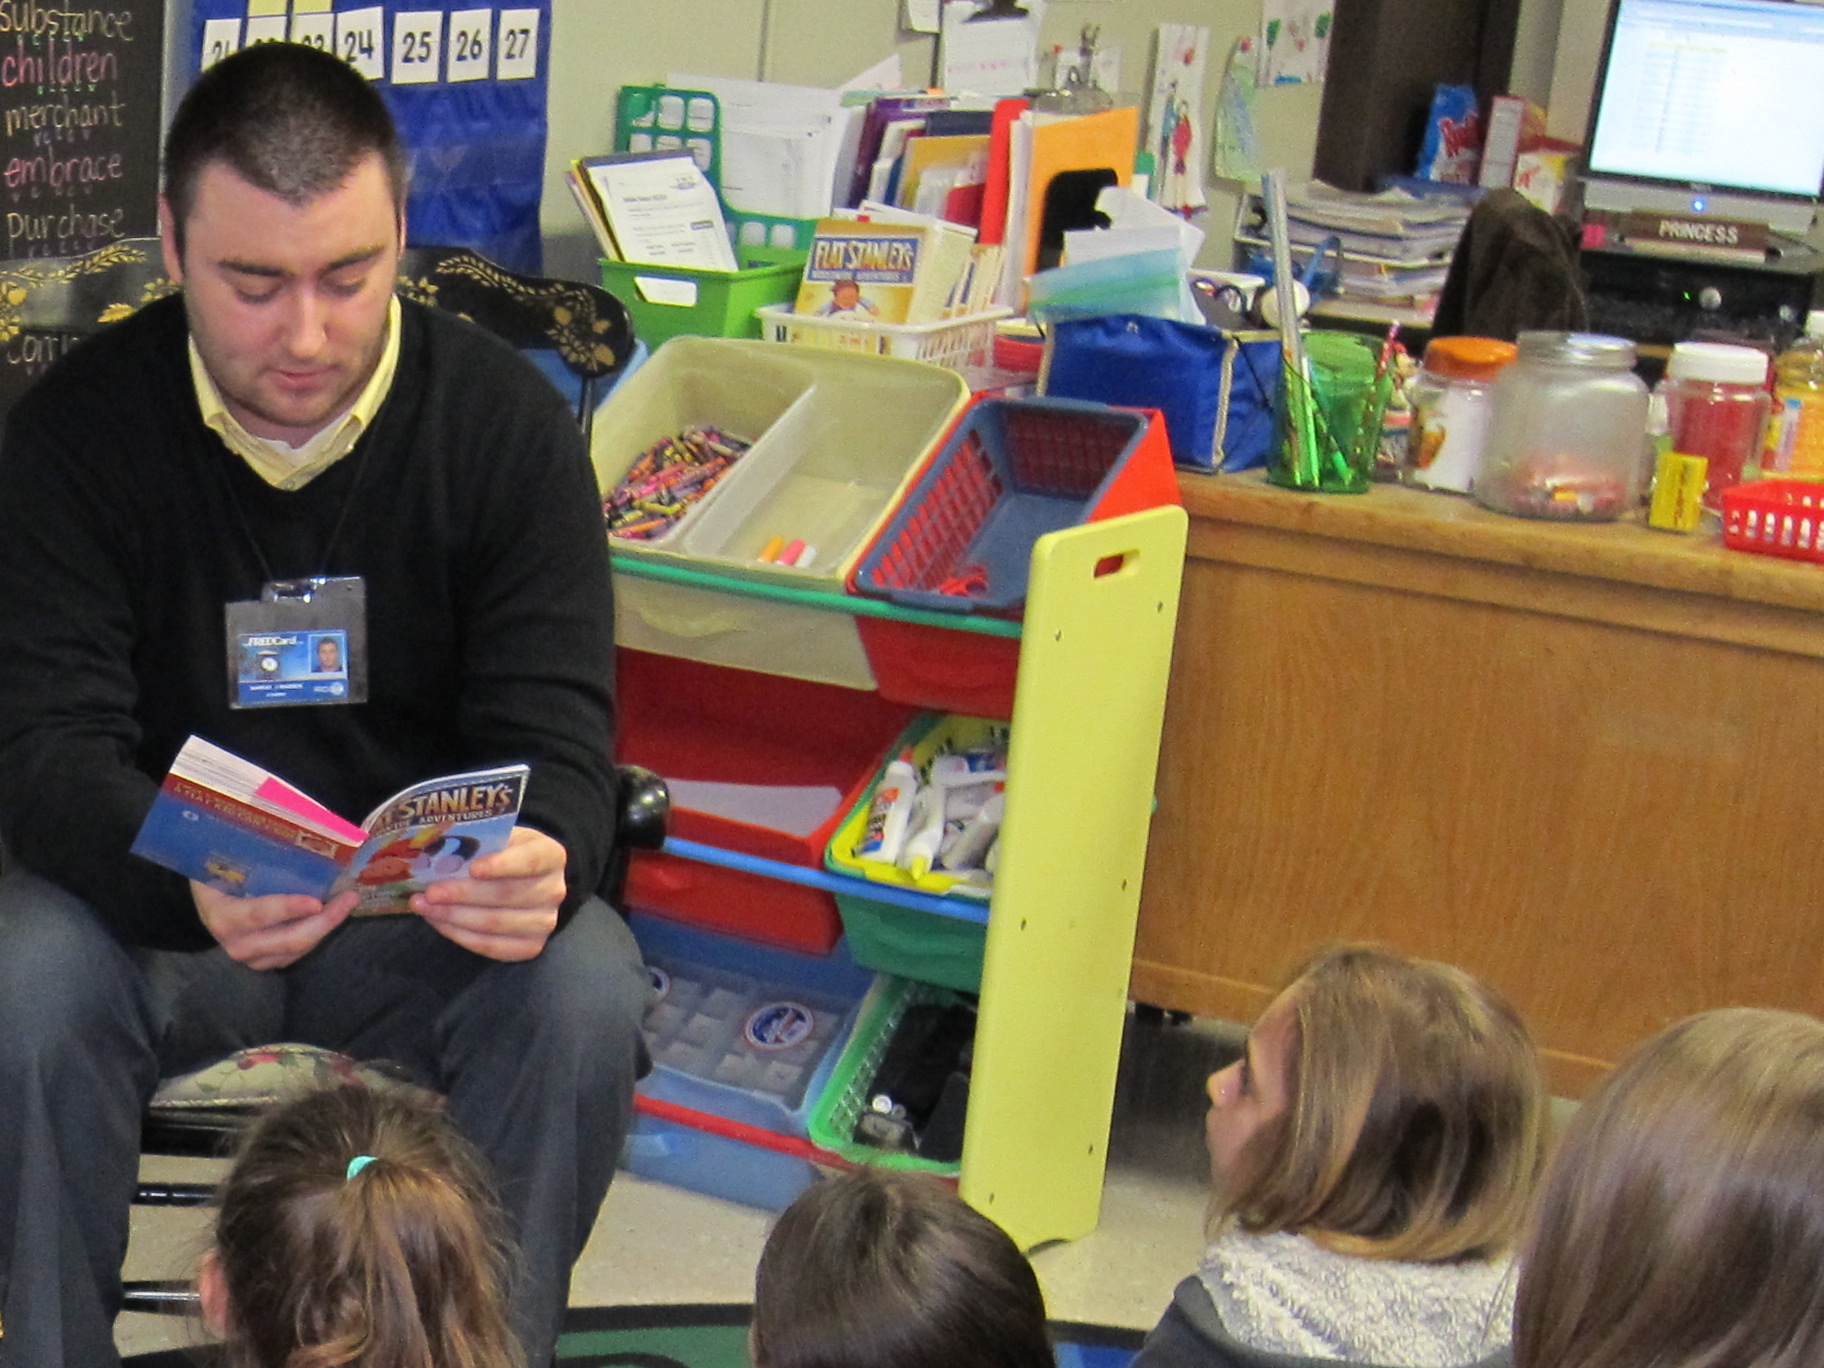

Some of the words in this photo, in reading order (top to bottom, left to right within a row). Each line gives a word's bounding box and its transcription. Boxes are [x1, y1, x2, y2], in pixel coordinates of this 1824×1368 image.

[1, 38, 118, 87] children
[343, 28, 374, 62] 24
[402, 30, 432, 63] 25
[455, 28, 483, 62] 26
[504, 28, 531, 60] 27
[4, 89, 126, 137] merchant
[3, 145, 124, 188] embrace
[1658, 219, 1739, 245] PRINCESS
[419, 810, 493, 826] ADVENTURES
